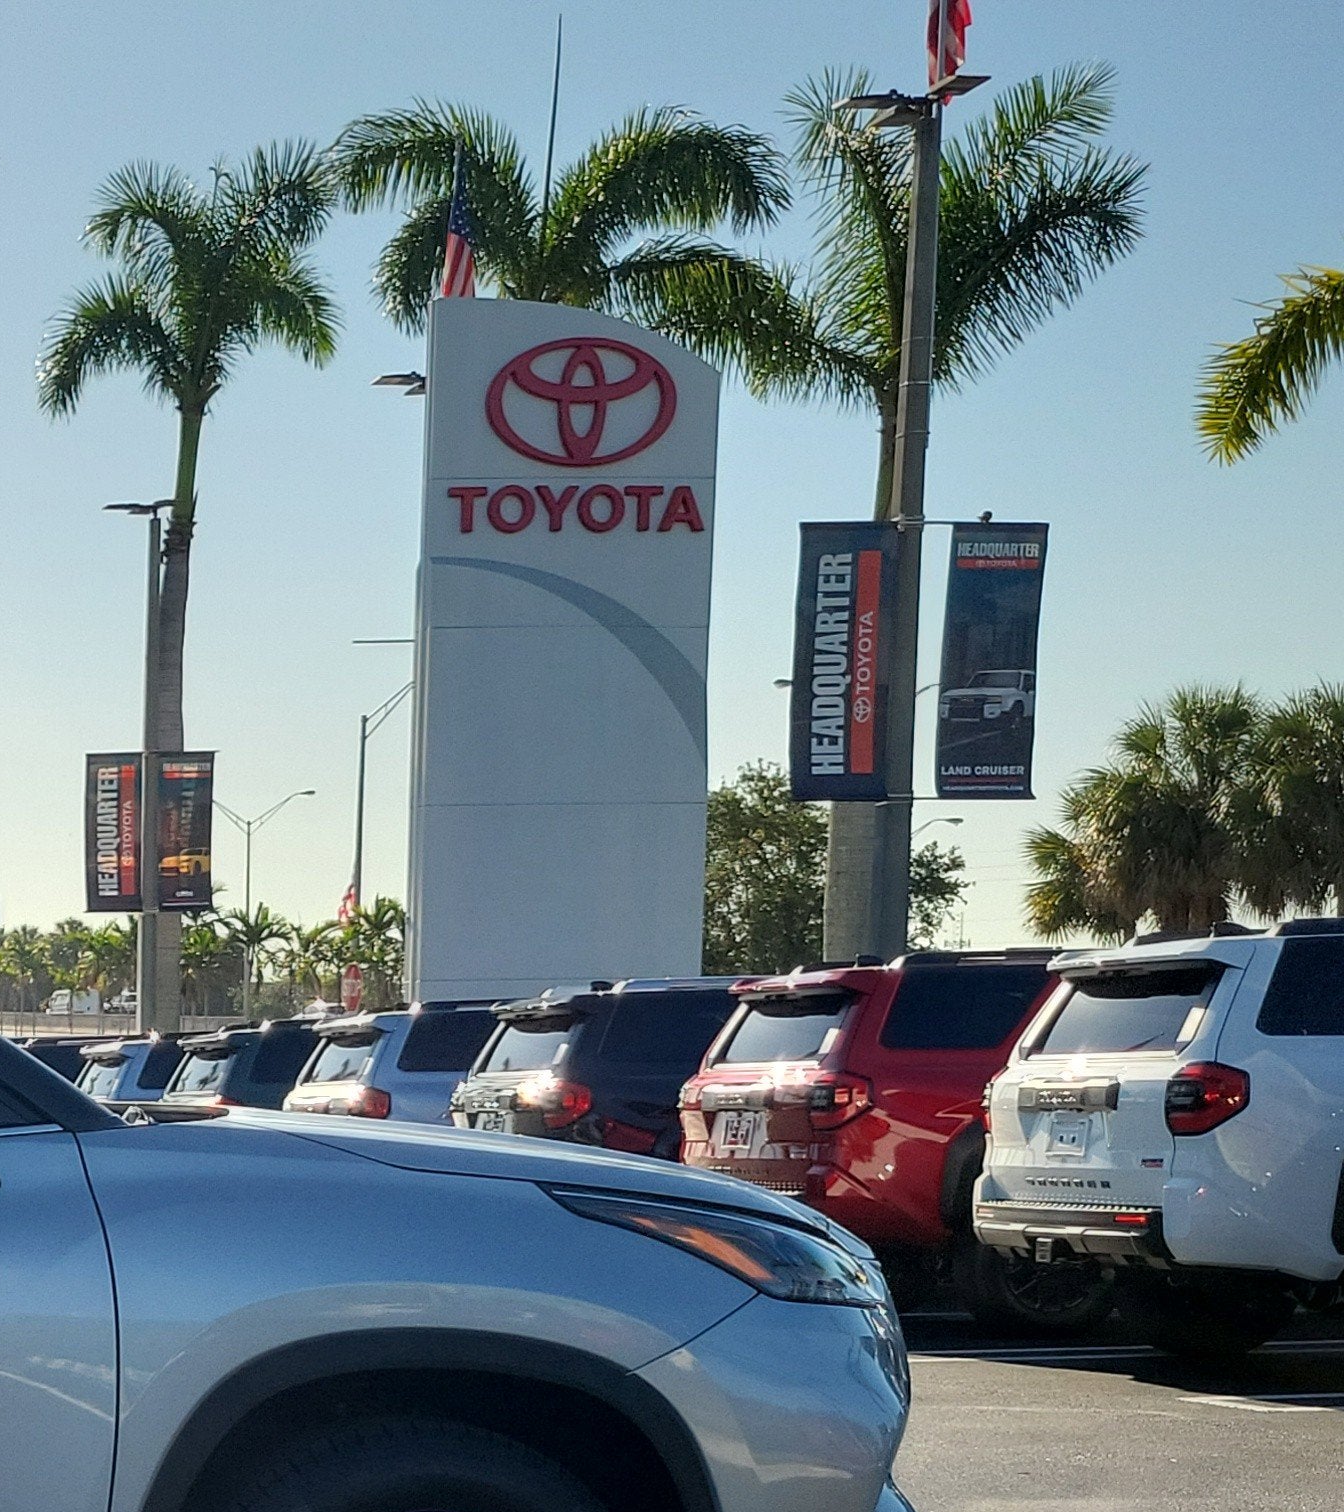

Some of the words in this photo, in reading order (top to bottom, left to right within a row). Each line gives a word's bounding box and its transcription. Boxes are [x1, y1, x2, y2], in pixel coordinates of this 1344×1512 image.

[447, 484, 705, 533] TOYOTA
[958, 542, 1039, 558] HEADQUARTER
[811, 553, 853, 775] HEADQUARTER
[855, 611, 874, 693] TOYOTA
[941, 765, 972, 775] LAND
[974, 765, 1025, 775] CRUISER
[97, 766, 120, 896] HEADQUARTER
